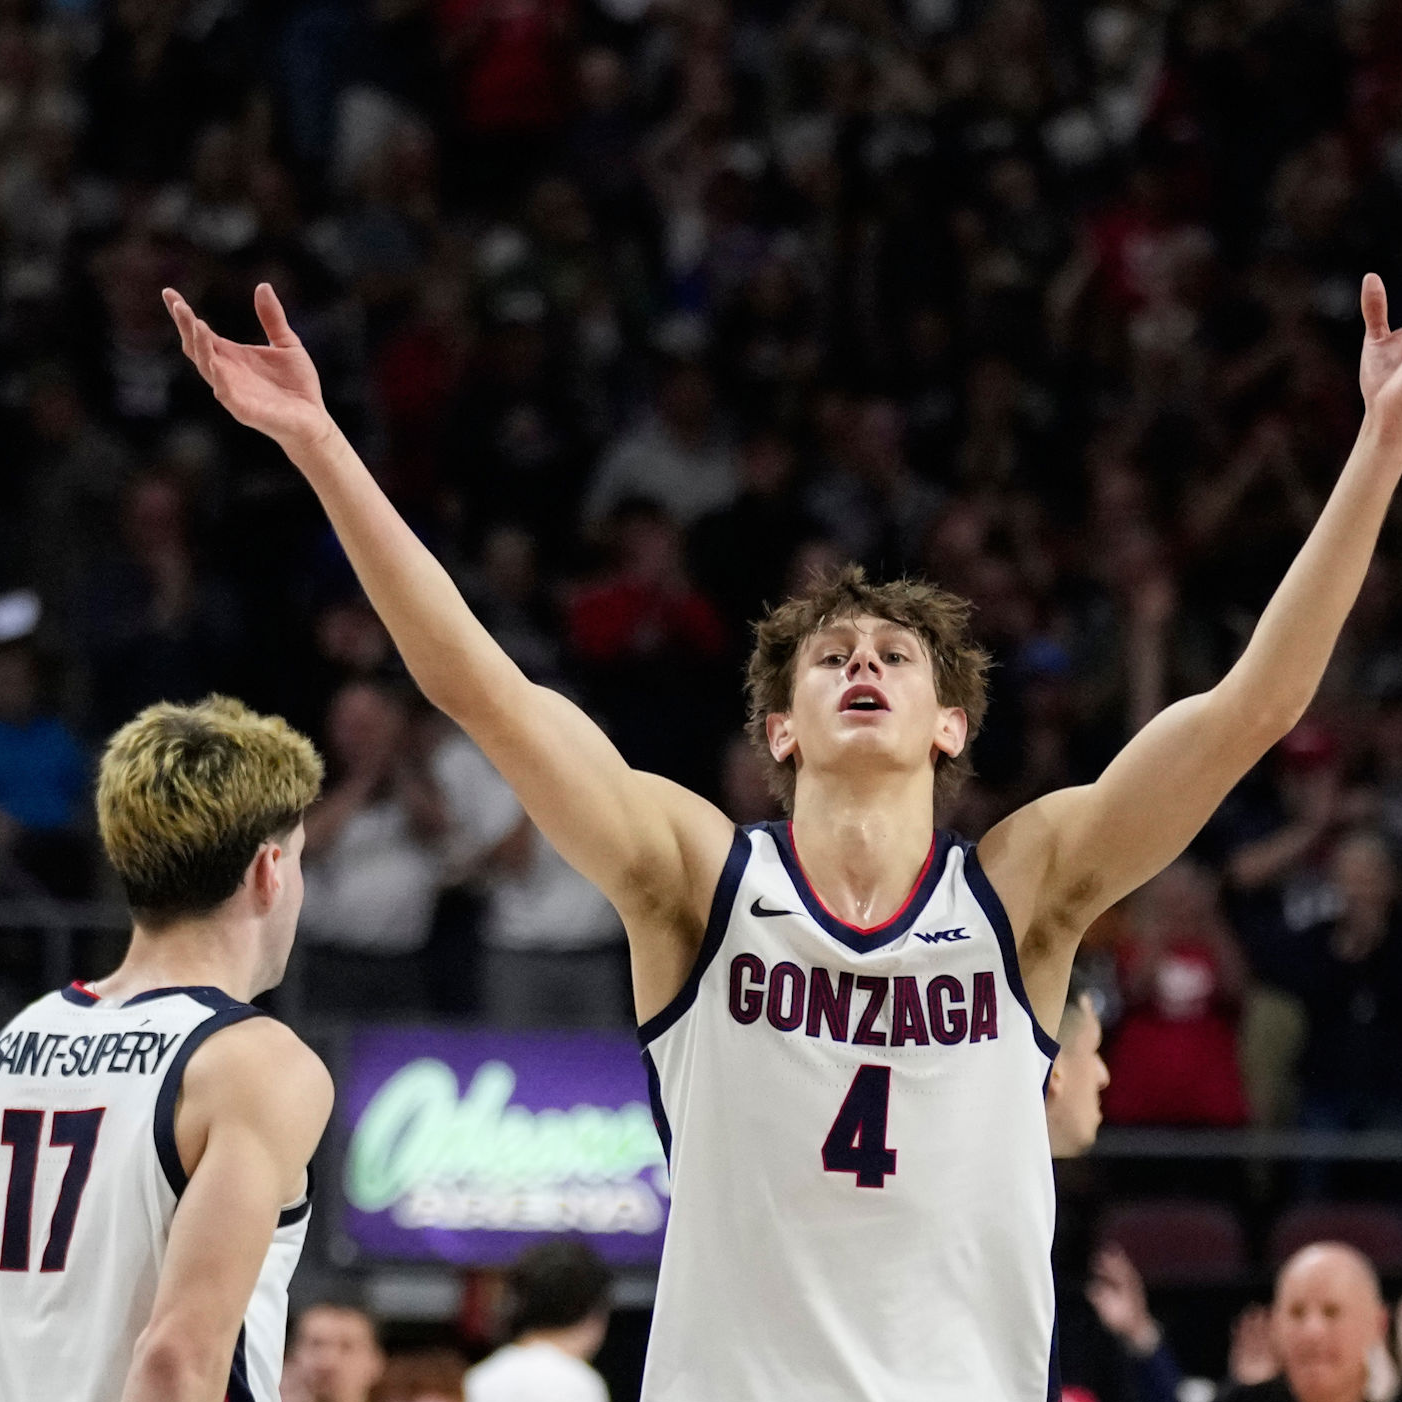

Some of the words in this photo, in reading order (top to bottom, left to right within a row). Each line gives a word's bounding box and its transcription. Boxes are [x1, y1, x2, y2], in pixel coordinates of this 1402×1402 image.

[913, 927, 971, 944] WCC
[729, 953, 998, 1047] GONZAGA
[821, 1064, 897, 1188] 4
